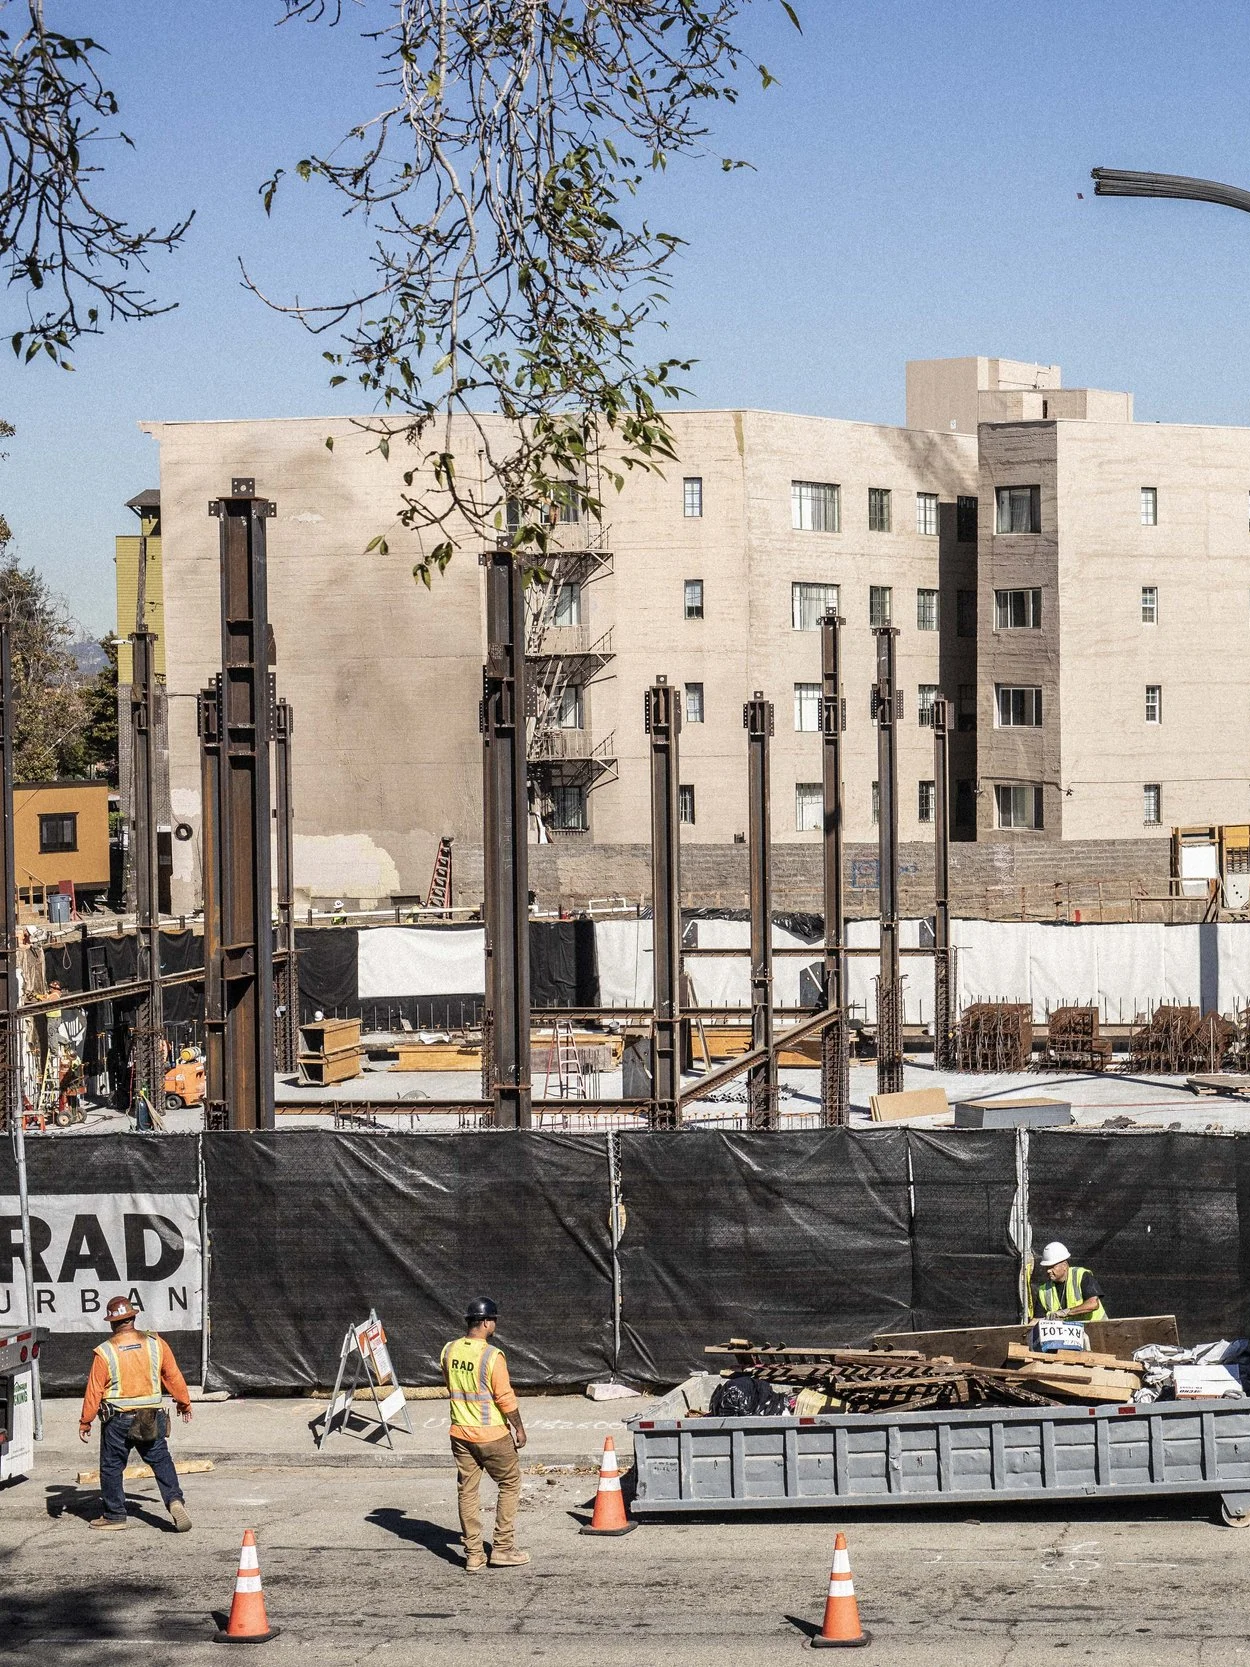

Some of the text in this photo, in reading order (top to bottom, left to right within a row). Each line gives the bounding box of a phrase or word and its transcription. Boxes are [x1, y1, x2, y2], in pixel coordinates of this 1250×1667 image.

[0, 1214, 184, 1283] RAD
[1041, 1327, 1081, 1339] RX-101
[452, 1359, 474, 1371] RAD
